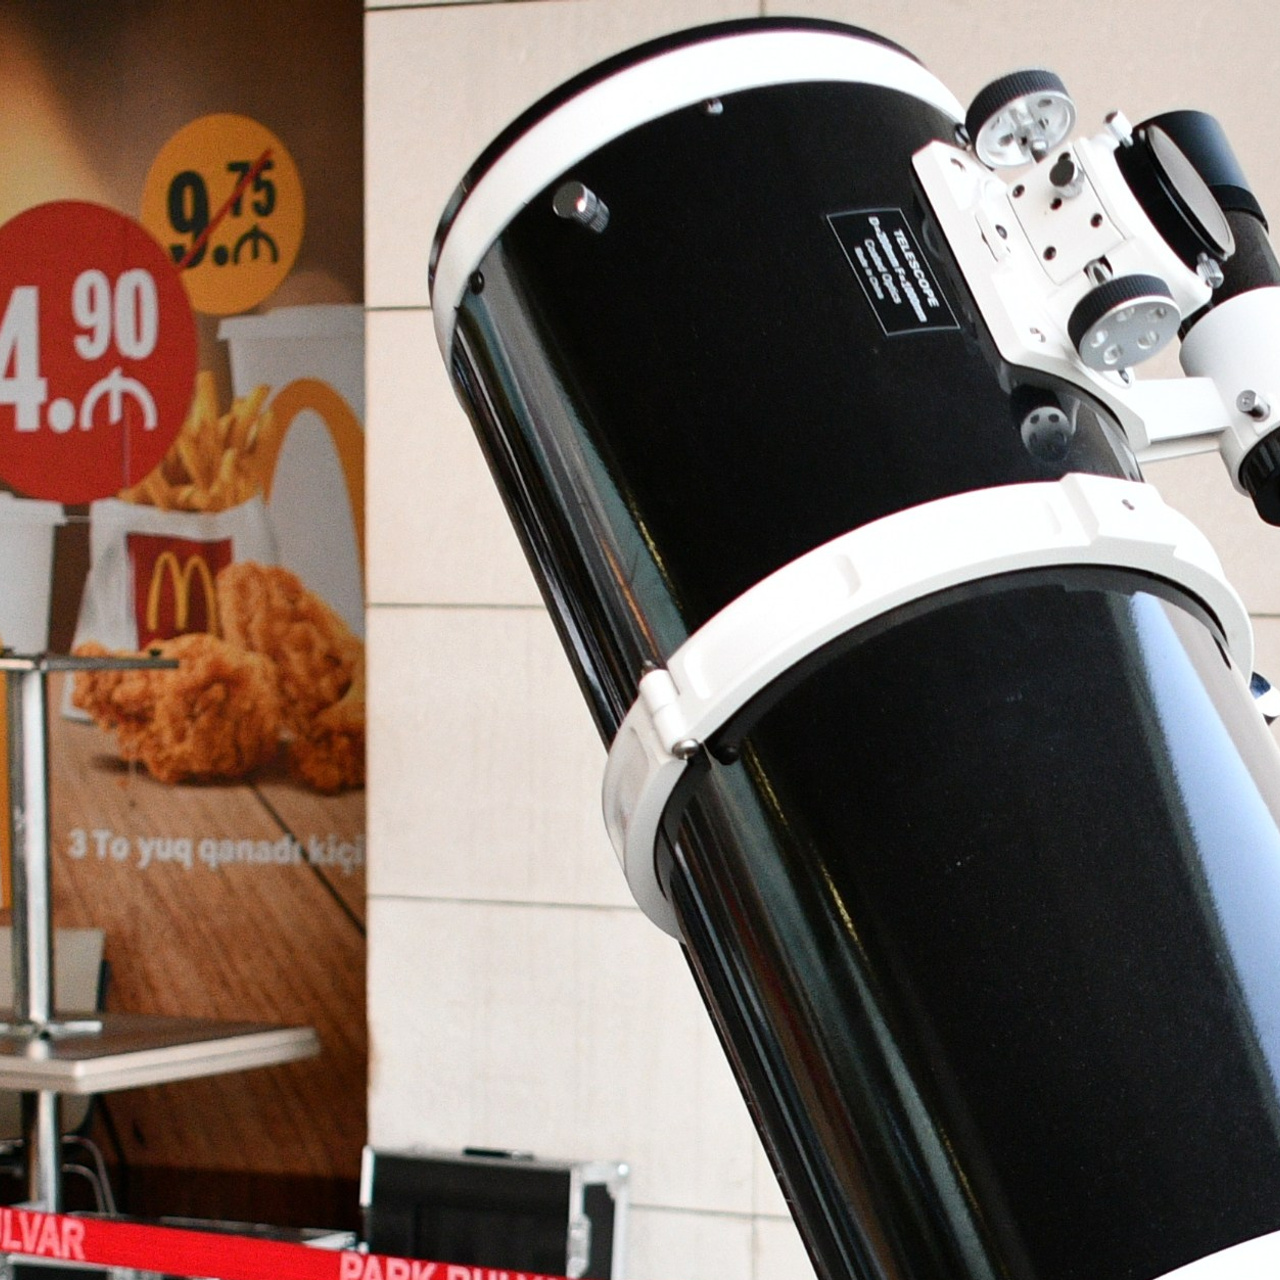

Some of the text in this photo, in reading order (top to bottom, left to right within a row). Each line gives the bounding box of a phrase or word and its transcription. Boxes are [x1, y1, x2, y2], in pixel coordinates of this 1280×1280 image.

[882, 273, 902, 305] Optics
[893, 228, 940, 308] TELESCOPE
[69, 828, 88, 860] 3
[0, 1208, 86, 1260] LVAR
